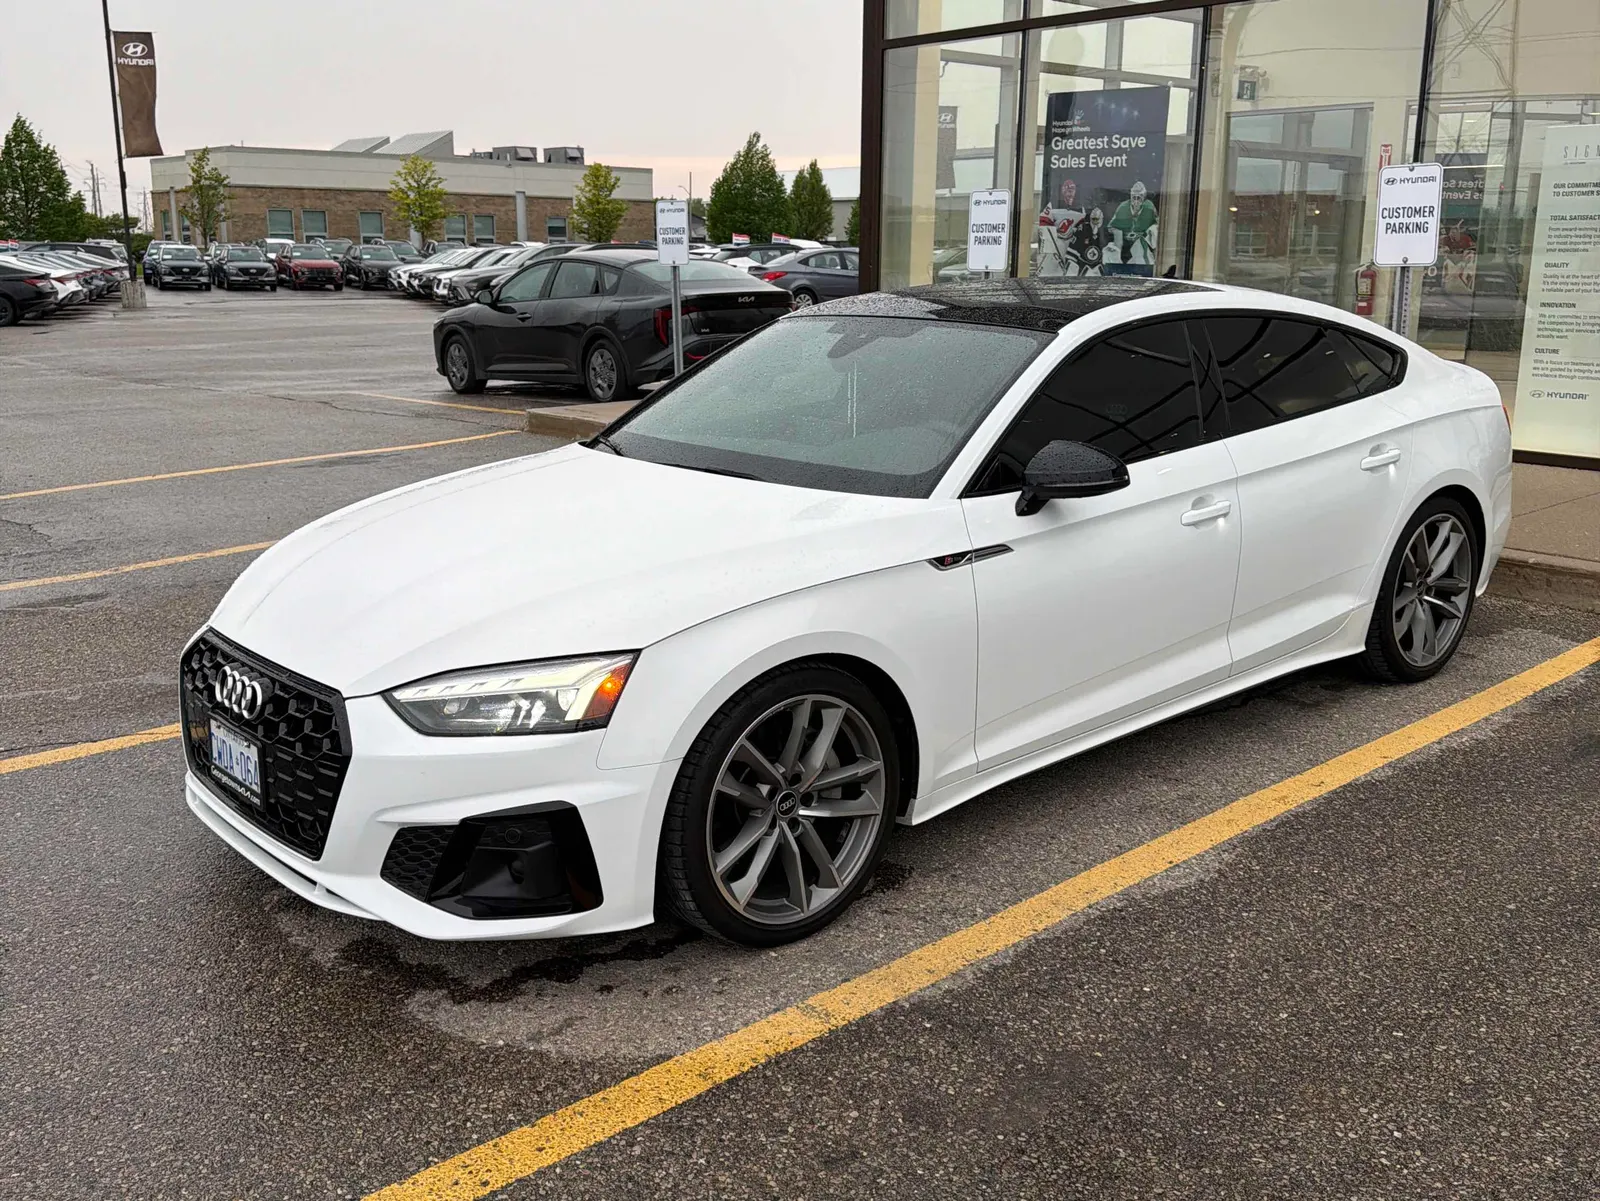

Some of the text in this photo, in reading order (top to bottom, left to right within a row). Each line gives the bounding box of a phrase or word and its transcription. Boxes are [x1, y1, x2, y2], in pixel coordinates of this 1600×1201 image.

[117, 57, 154, 66] HYUNDAI
[1051, 134, 1146, 150] Greatest Save
[1050, 153, 1128, 168] Sales Event
[1400, 176, 1436, 184] HYUNDAI
[1381, 206, 1435, 219] CUSTOMER
[659, 227, 685, 235] CUSTOMER
[972, 223, 1005, 233] CUSTOMER
[1385, 221, 1429, 234] PARKING
[662, 237, 684, 245] PARKING
[974, 236, 1002, 246] PARKING
[1546, 392, 1587, 400] HYUNDAI
[240, 750, 260, 789] 064
